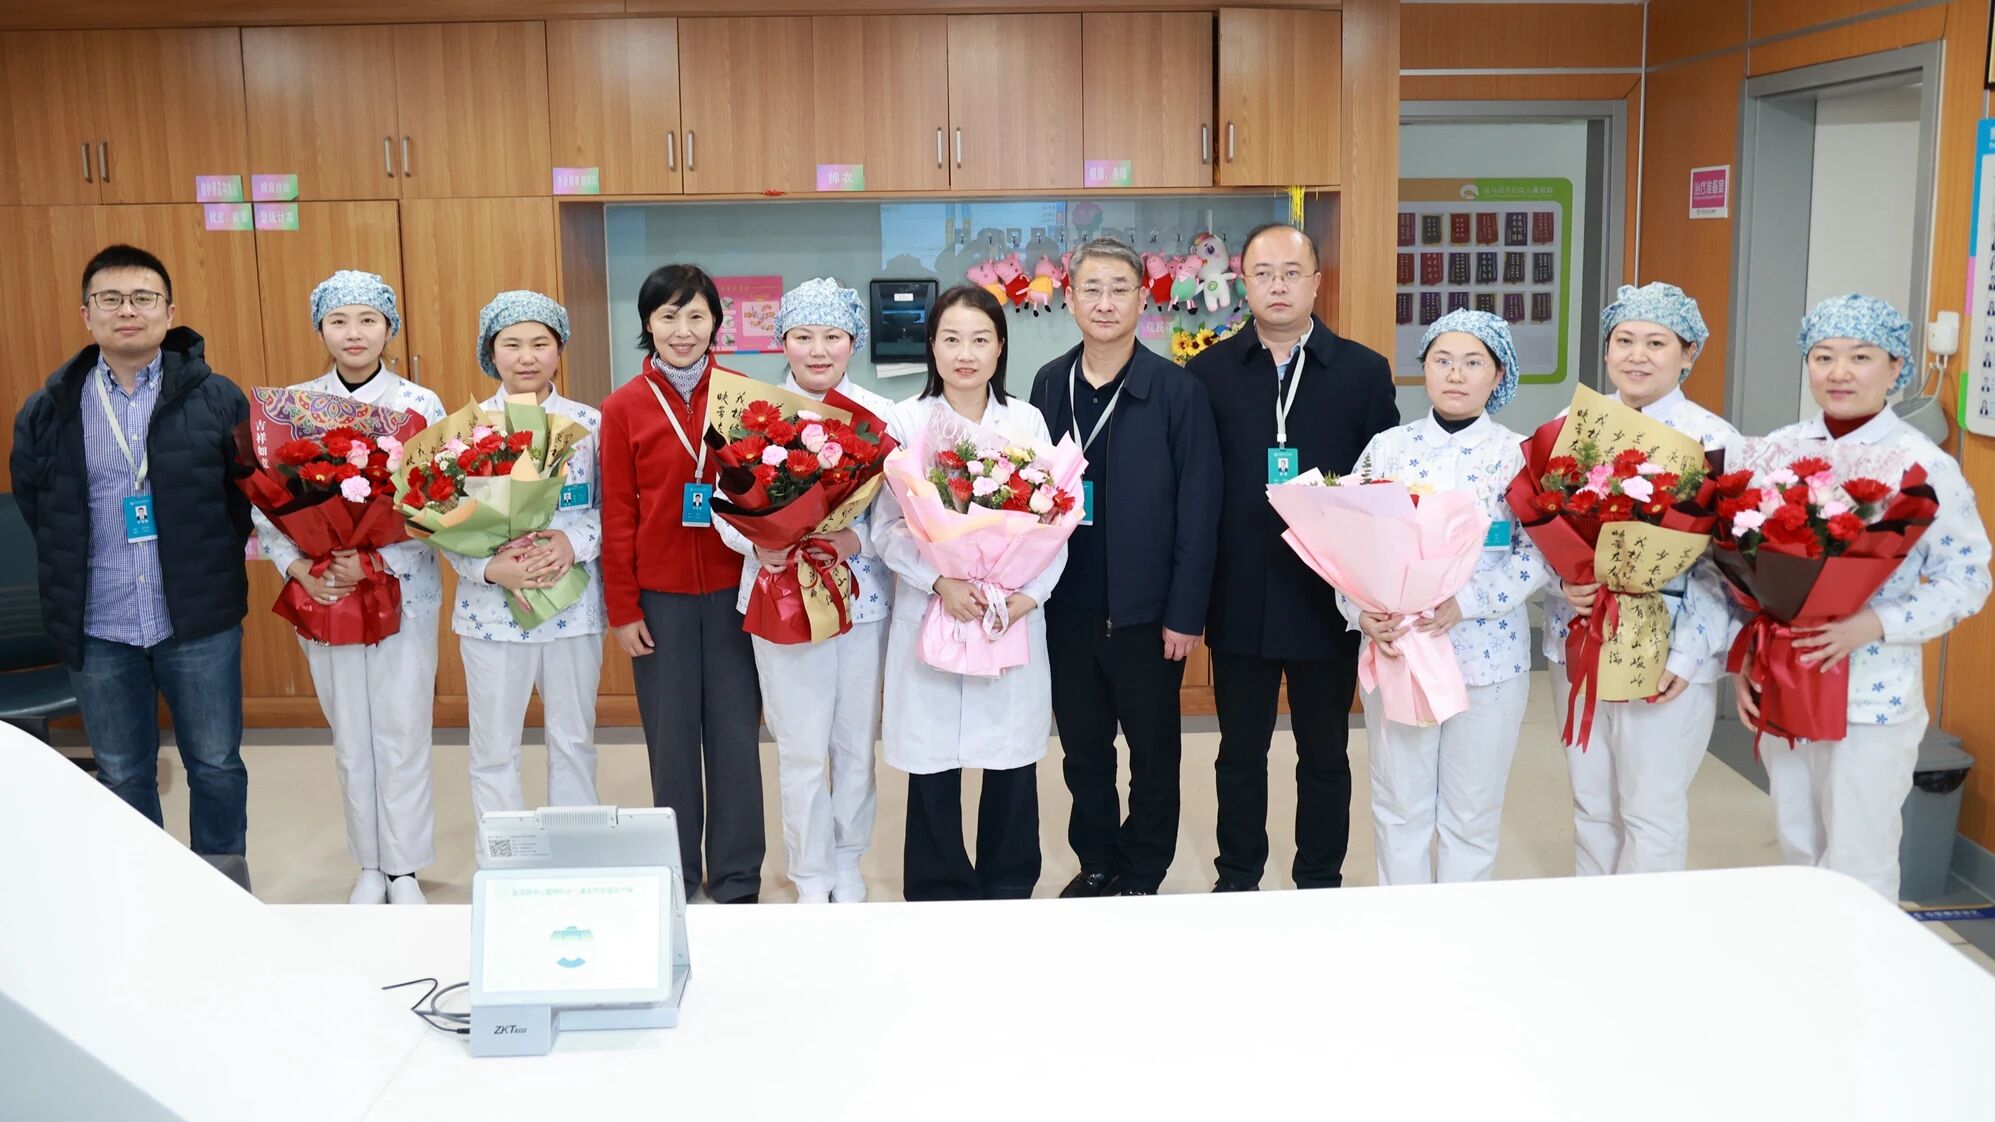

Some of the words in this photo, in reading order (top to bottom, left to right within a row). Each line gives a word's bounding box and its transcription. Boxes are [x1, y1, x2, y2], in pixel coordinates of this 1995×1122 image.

[1694, 180, 1724, 196] 治疗准备室
